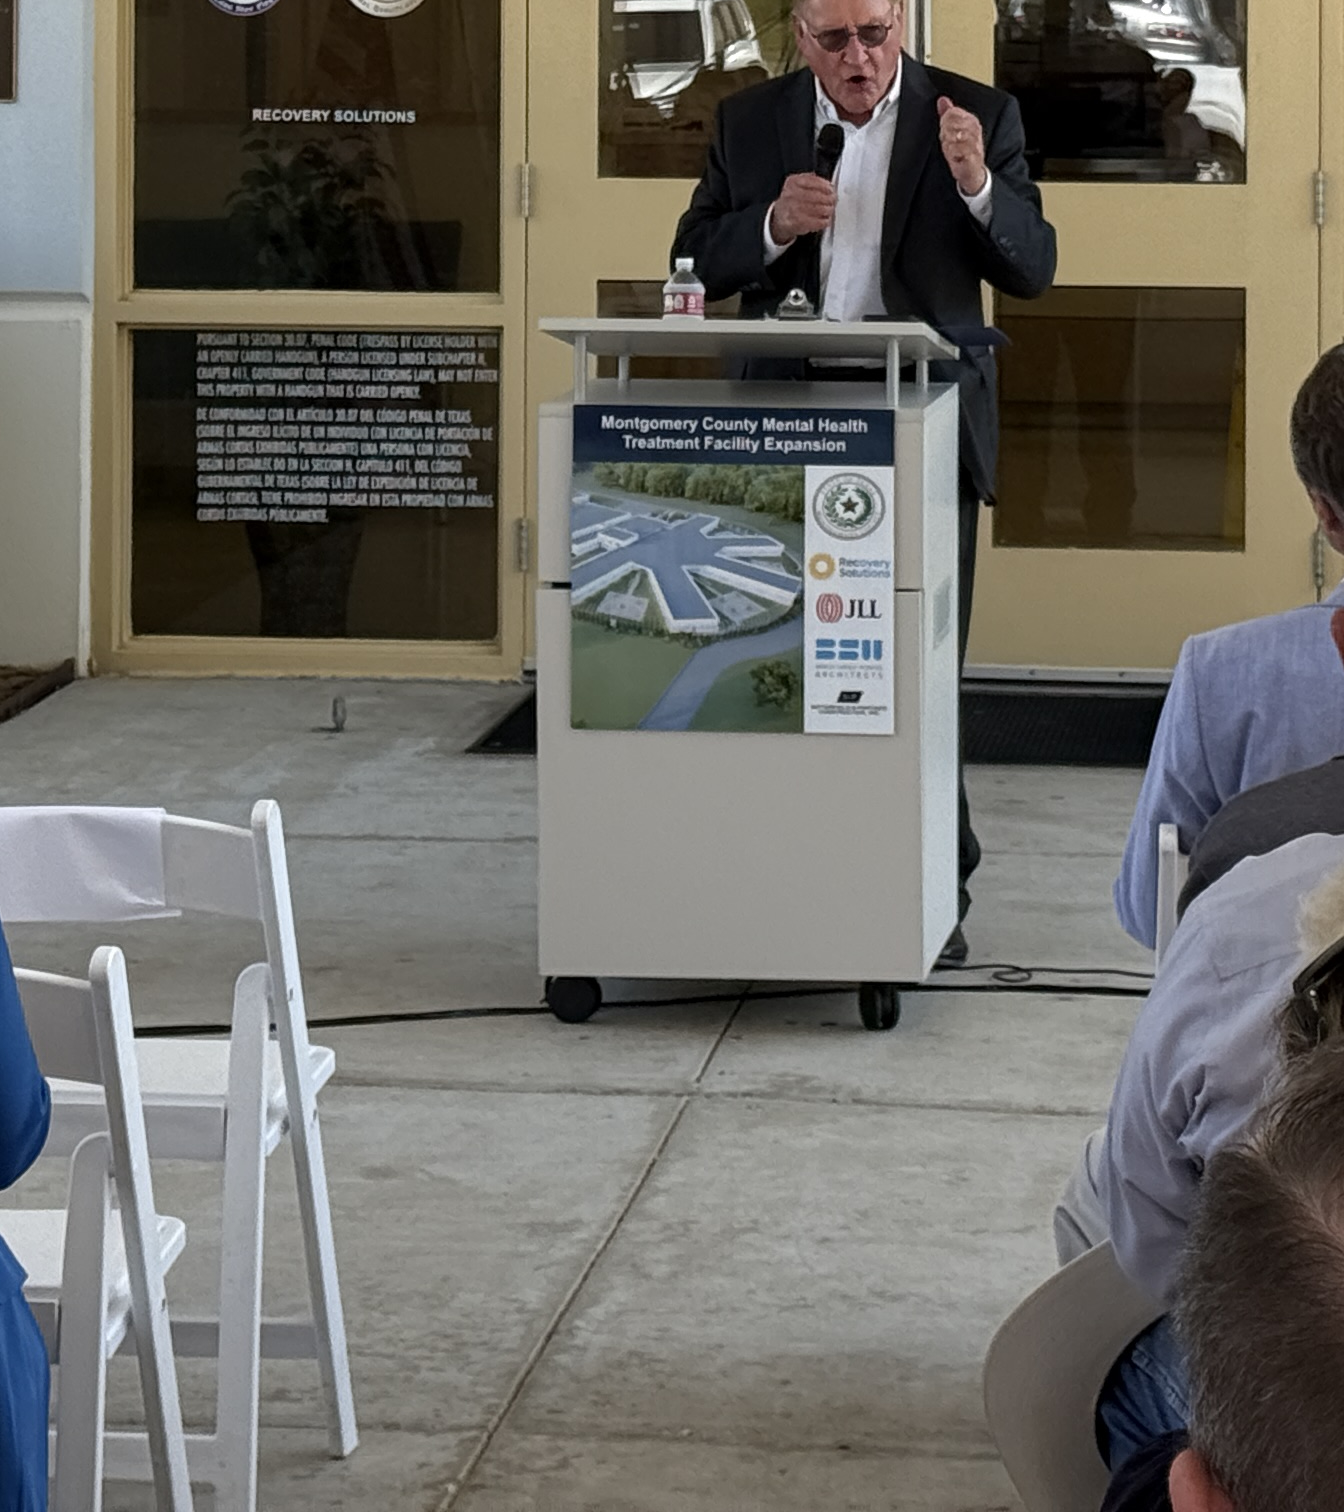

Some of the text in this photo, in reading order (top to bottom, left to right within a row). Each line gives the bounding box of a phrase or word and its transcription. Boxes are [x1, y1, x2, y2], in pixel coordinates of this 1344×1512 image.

[252, 108, 416, 123] RECOVERY SOLUTIONS
[600, 415, 869, 435] Montgomery County Mental Health
[621, 434, 847, 455] Treatment Facility Expansion
[838, 557, 891, 569] Recovery
[839, 568, 891, 578] Solutions
[844, 598, 883, 619] JLL
